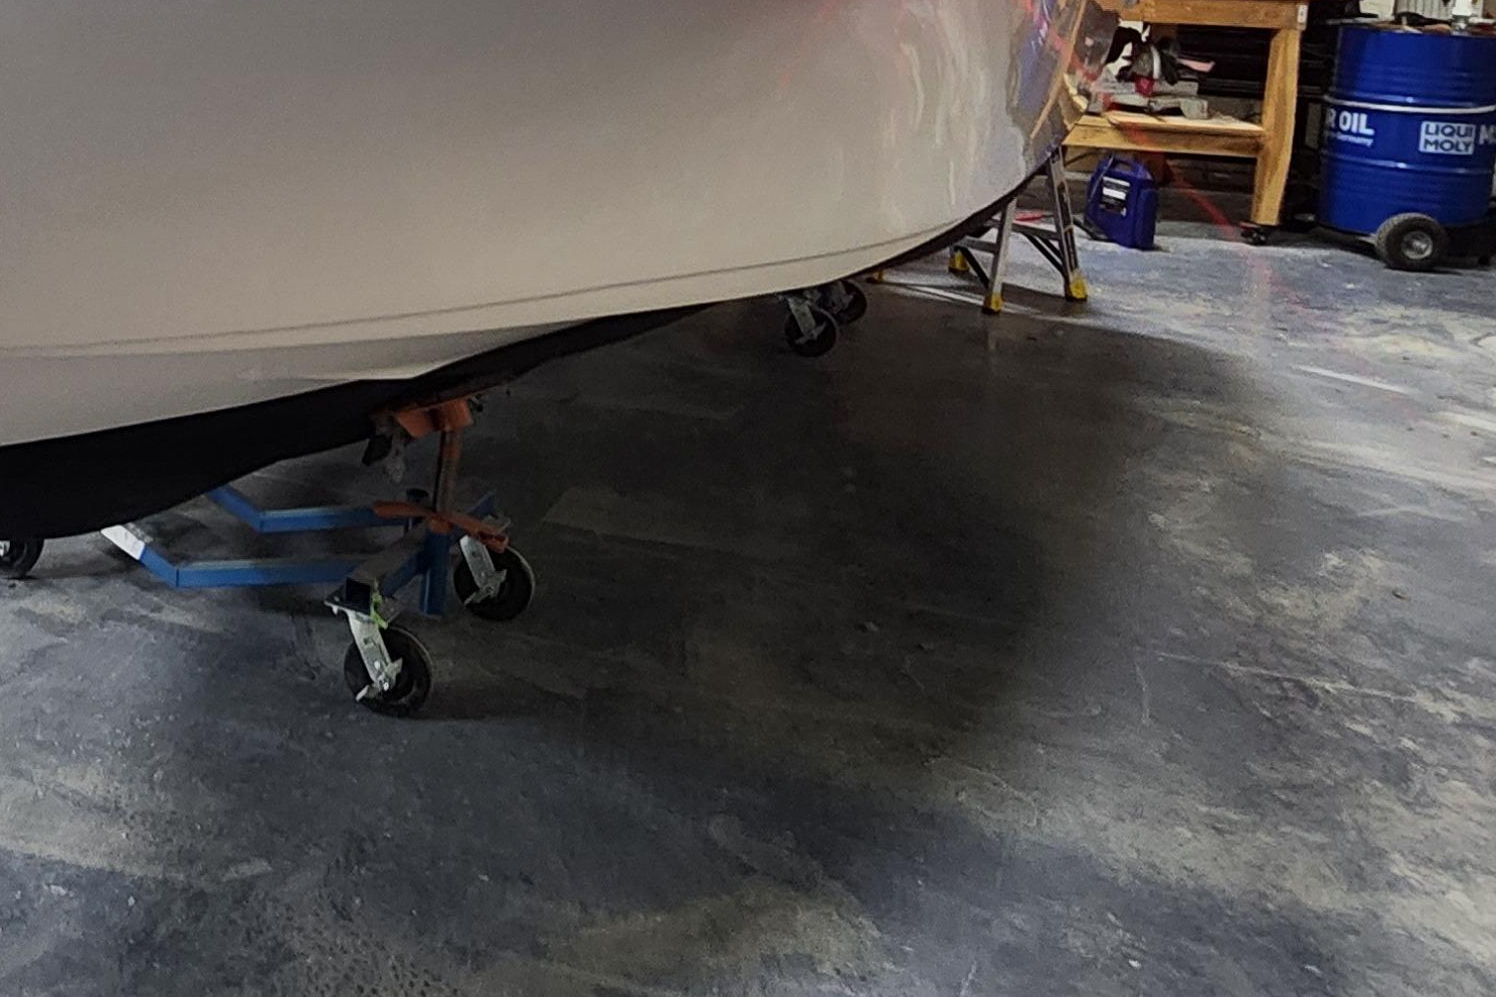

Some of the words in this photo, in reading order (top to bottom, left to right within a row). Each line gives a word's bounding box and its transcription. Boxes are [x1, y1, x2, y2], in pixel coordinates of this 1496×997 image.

[1338, 110, 1375, 136] OIL
[1424, 123, 1473, 138] LIQUI
[1423, 138, 1472, 153] MOLY
